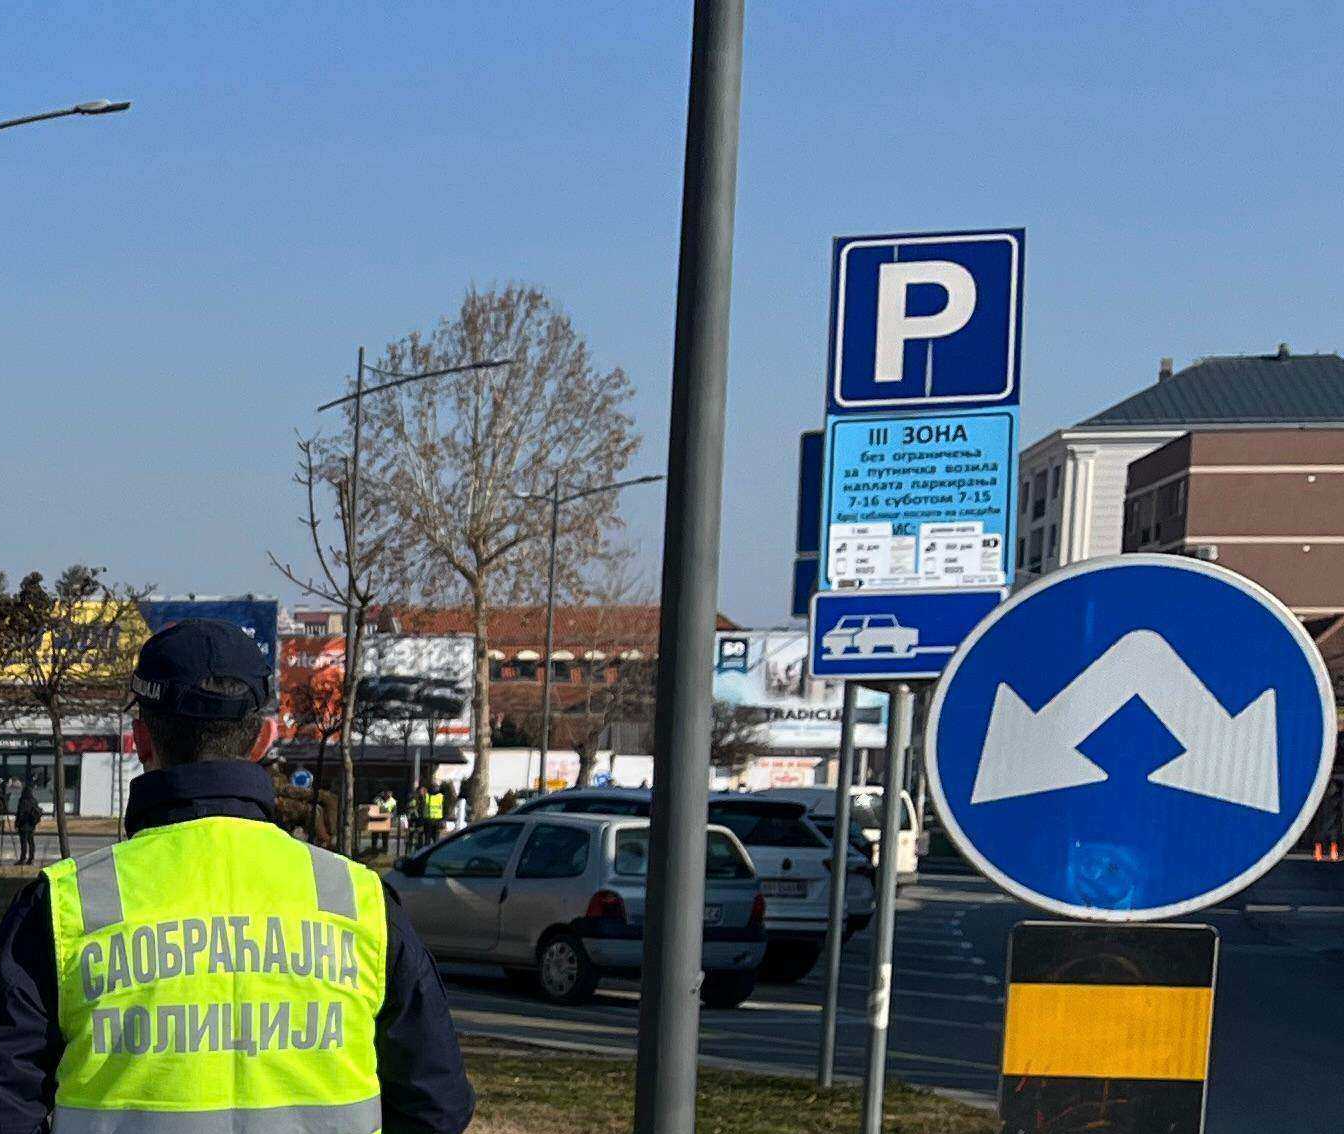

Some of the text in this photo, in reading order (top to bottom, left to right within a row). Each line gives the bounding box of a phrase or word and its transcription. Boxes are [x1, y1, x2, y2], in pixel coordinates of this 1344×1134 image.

[875, 259, 978, 384] P
[869, 425, 968, 446] III ЗОНА
[860, 450, 885, 463] без
[885, 493, 954, 508] суботом
[81, 915, 359, 1002] САОБРАЋАЈНА
[92, 1001, 344, 1058] ПОЛИЦИЈА
